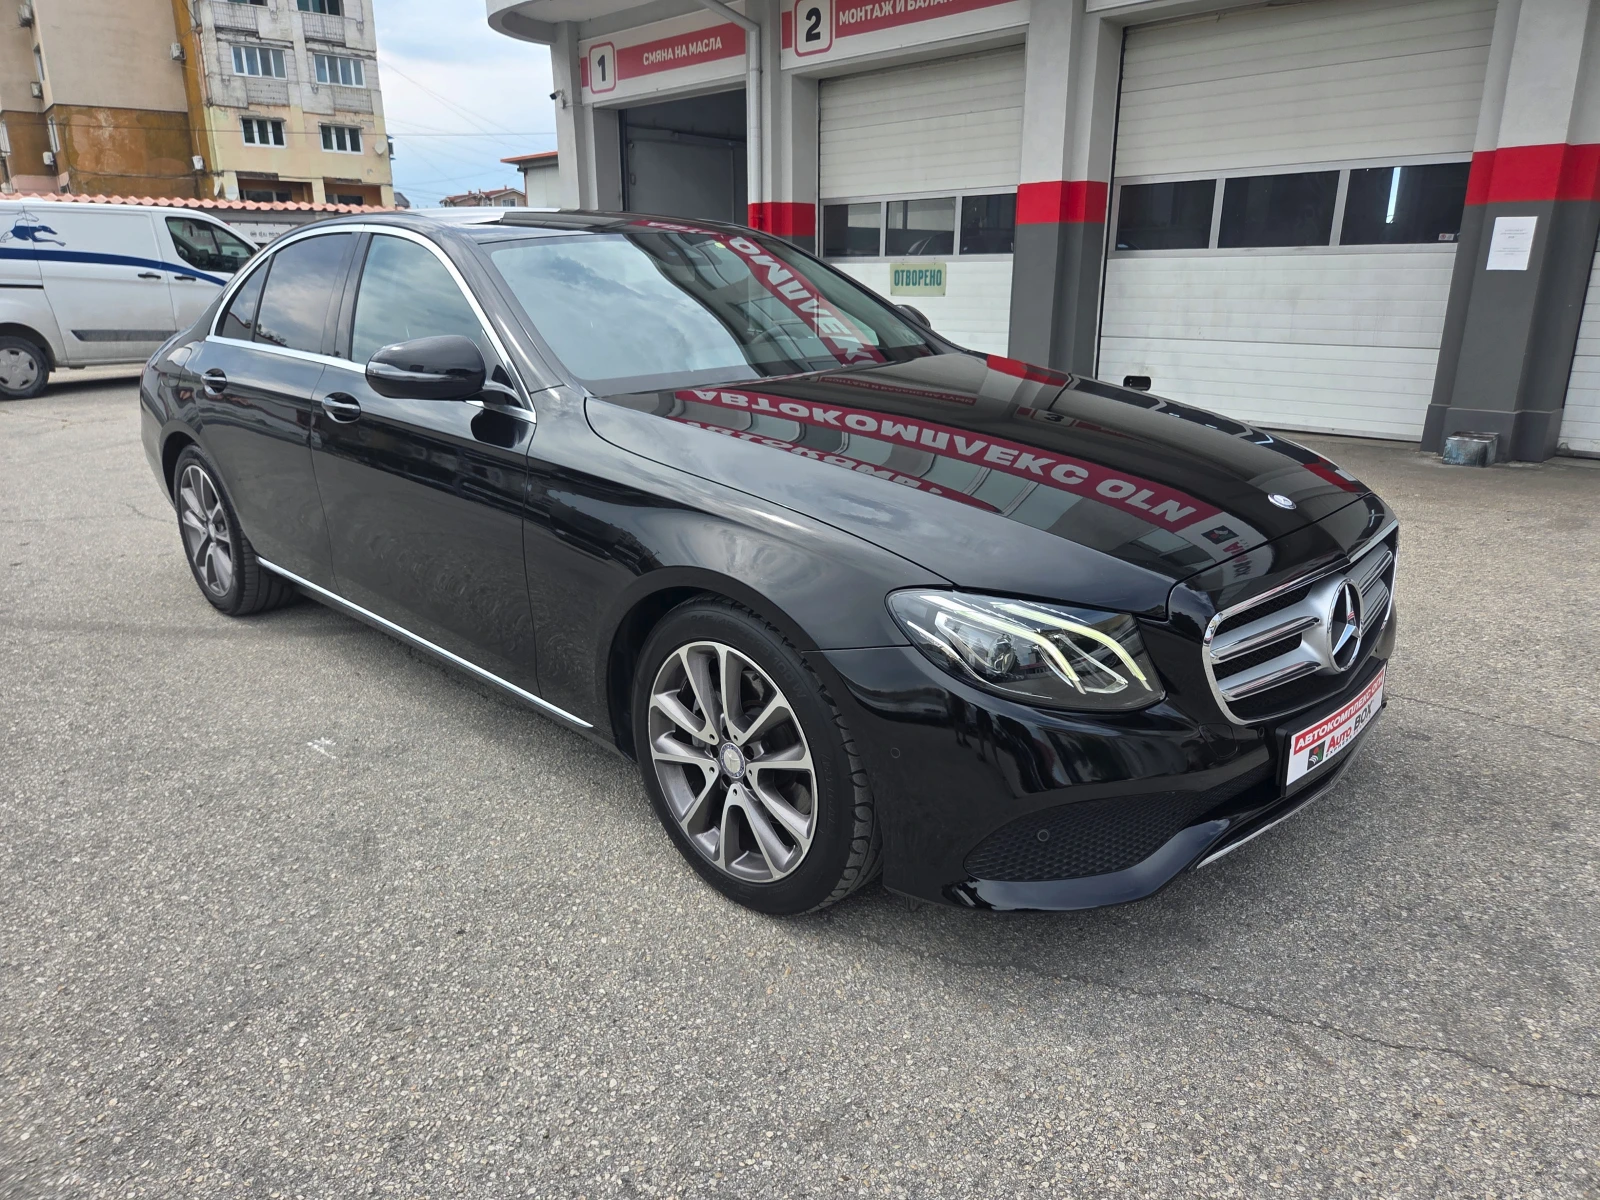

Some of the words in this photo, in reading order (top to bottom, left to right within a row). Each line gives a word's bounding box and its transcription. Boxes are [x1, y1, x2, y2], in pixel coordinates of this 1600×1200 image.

[805, 7, 822, 42] 2
[839, 0, 894, 25] МОНТАЖ
[643, 48, 674, 65] СМЯНА
[675, 44, 688, 59] НА
[689, 36, 722, 55] МАСЛА
[597, 54, 607, 82] 1
[894, 269, 942, 287] ОТВОРЕНО
[1354, 700, 1374, 731] BOX
